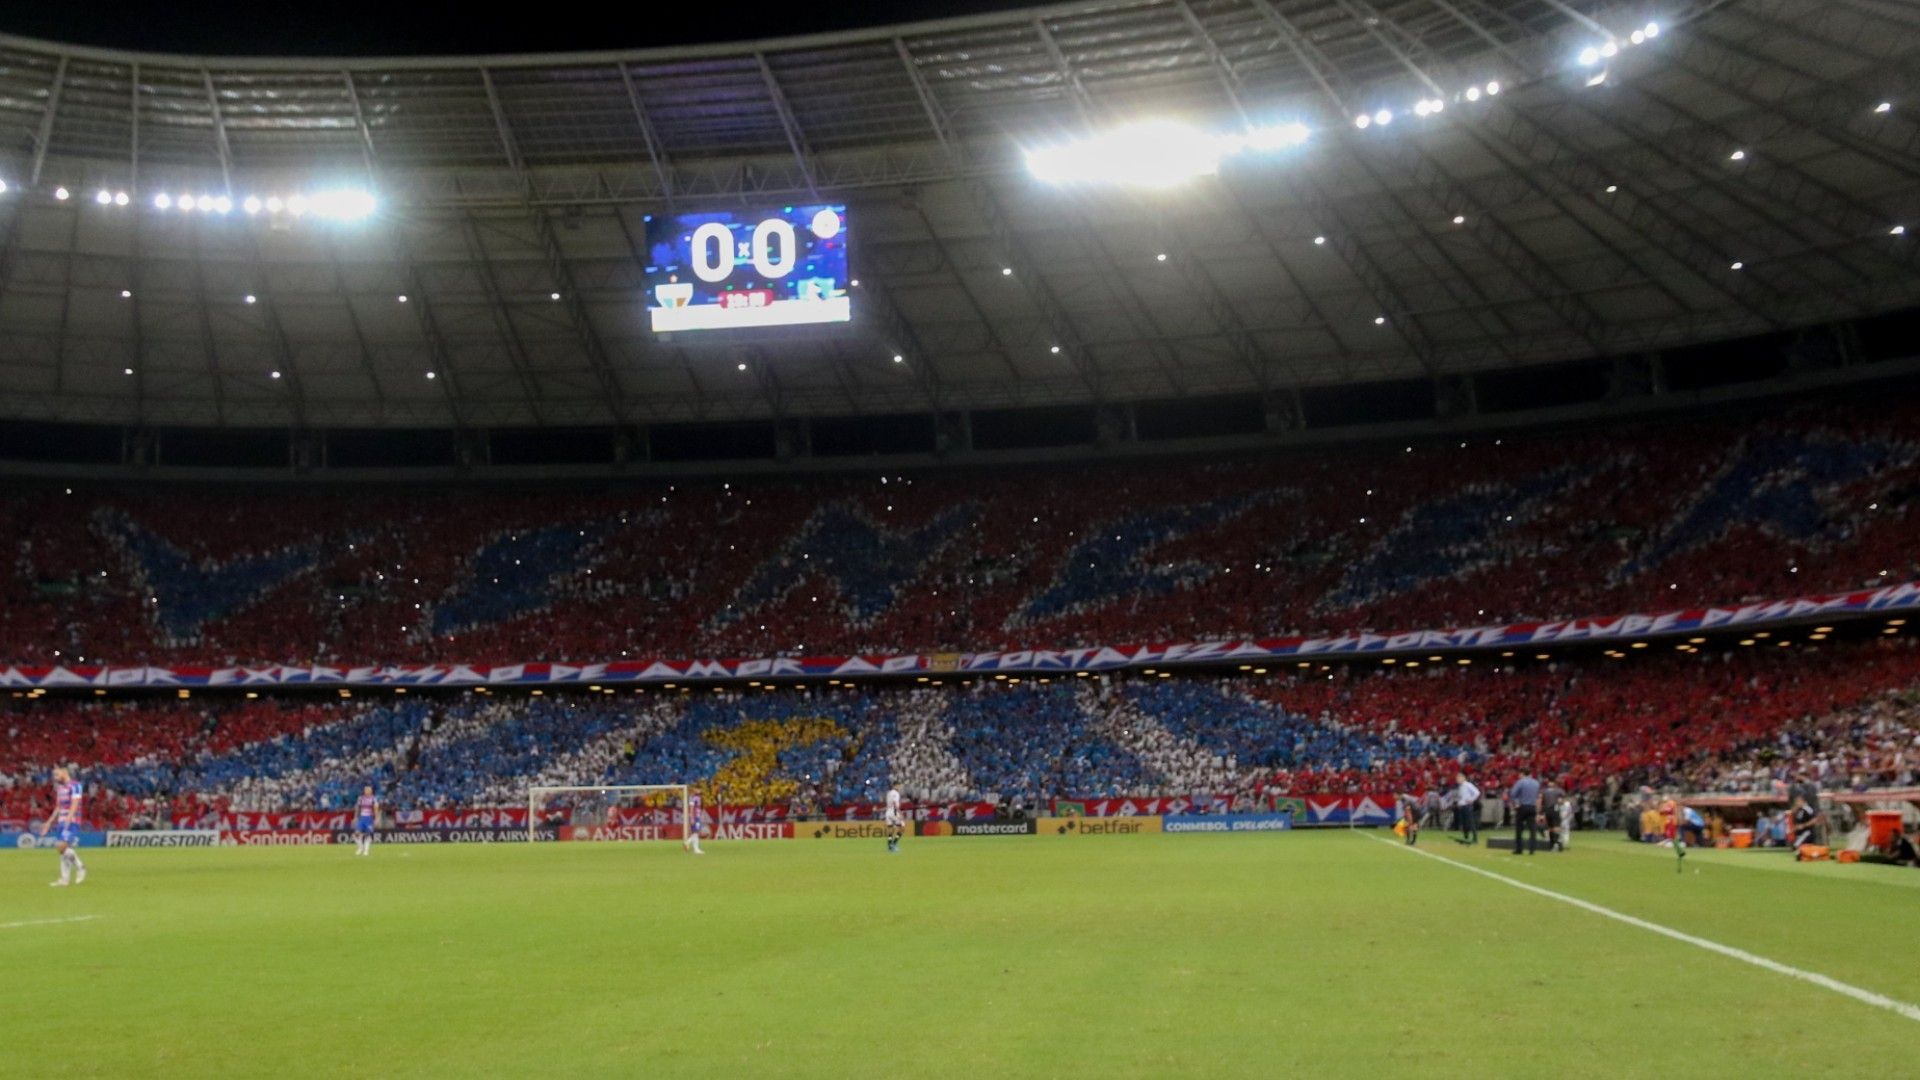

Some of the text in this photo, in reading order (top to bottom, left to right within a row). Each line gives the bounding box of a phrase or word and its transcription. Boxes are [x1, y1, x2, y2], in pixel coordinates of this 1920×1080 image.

[692, 222, 734, 282] 0
[753, 219, 795, 278] 0
[633, 659, 805, 679] AMOR
[832, 655, 918, 674] AO
[968, 641, 1272, 669] FORTALEZA
[592, 826, 663, 840] AMSTEL
[714, 823, 786, 840] AMSTEL
[957, 822, 1028, 834] mastercard
[1081, 821, 1142, 834] betfair
[1166, 821, 1229, 832] CONMEBOL
[110, 834, 216, 847] BRIDGESTONE
[240, 830, 332, 845] Santander
[385, 832, 441, 843] AIRWAYS
[449, 830, 555, 842] QATAR AIRWAYS
